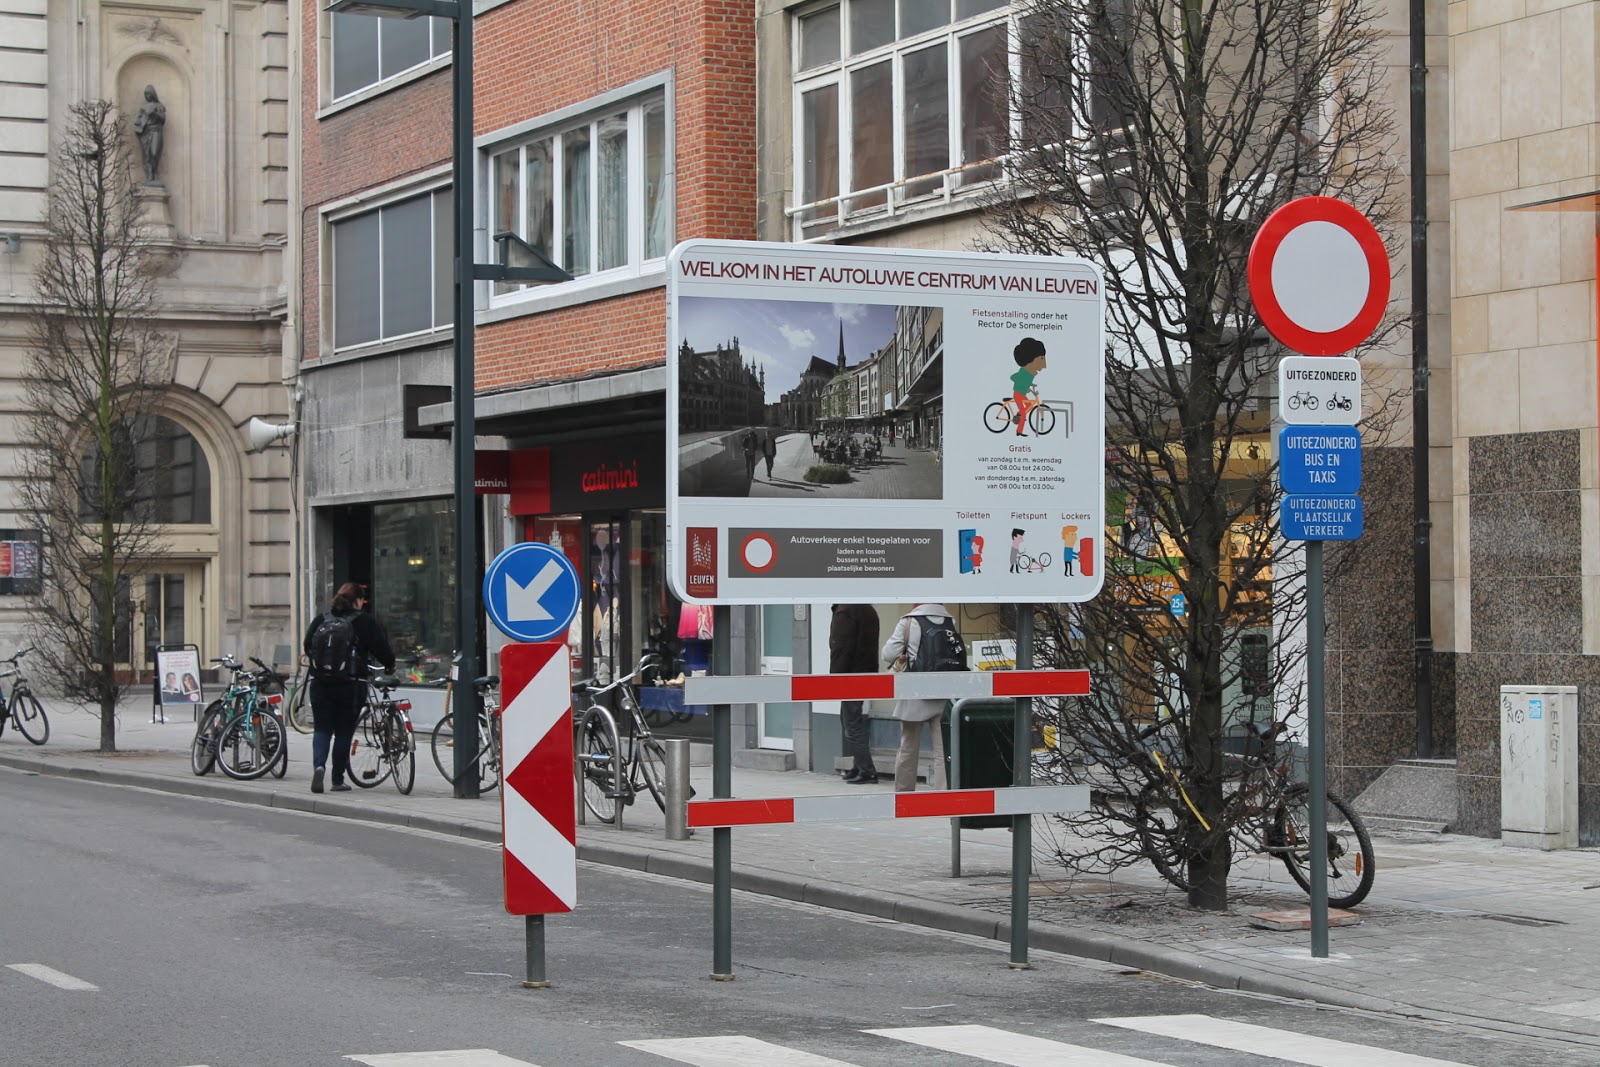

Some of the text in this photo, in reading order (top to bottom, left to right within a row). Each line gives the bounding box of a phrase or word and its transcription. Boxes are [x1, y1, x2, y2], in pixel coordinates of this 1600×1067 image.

[680, 260, 1097, 295] WELKOM IN HET AUTOLUWE CENTRUM VAN LEUVEN
[972, 308, 1028, 320] Fietsenstalling
[978, 320, 1063, 332] Rector De Somerplein
[1286, 370, 1357, 382] UITGEZONDERD
[1008, 444, 1032, 452] Gratis
[1287, 436, 1357, 450] UITGEZONDERD
[1304, 454, 1340, 466] BUS EN
[1308, 470, 1336, 484] TAXIS
[1290, 498, 1356, 510] UITGEZONDERD
[1010, 512, 1048, 520] Fietspunt
[1294, 512, 1352, 523] PLAATSELIJK
[1303, 526, 1344, 536] VERKEER
[790, 536, 841, 544] Autoverkeer
[842, 536, 865, 544] enkel
[866, 536, 910, 545] toegelaten
[828, 565, 863, 573] plaatselijke
[690, 574, 715, 584] LEUVEN
